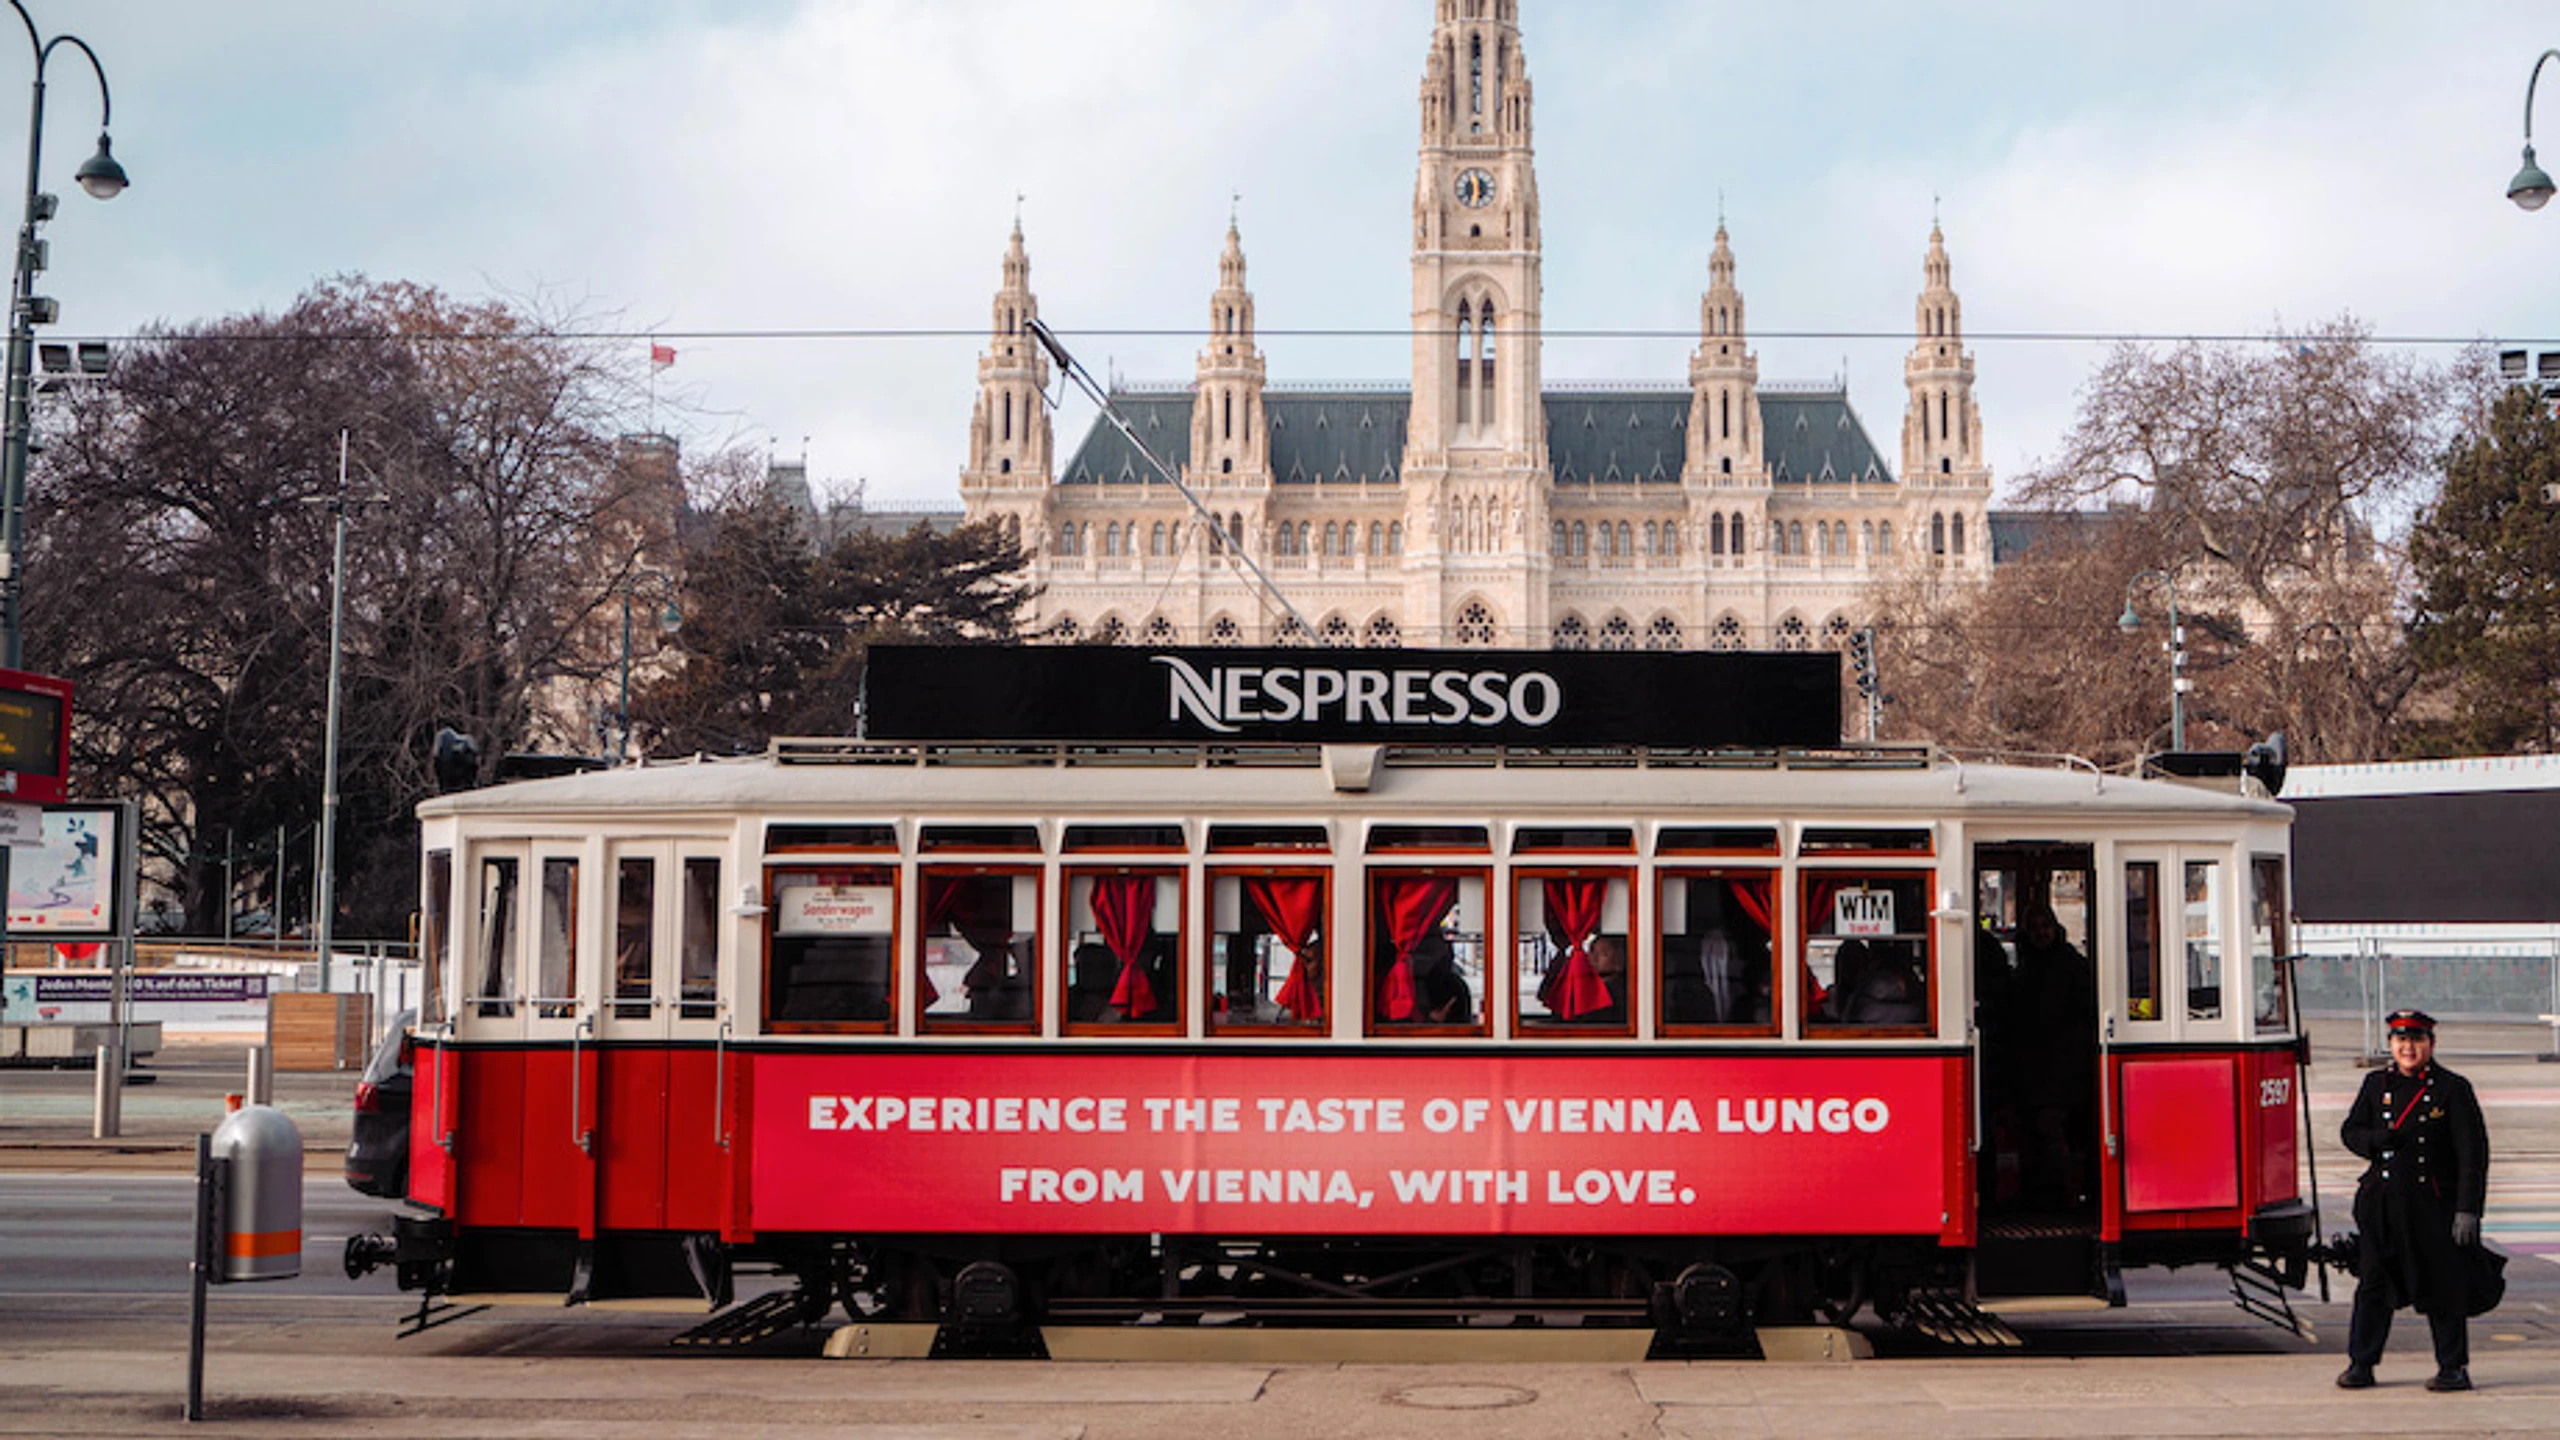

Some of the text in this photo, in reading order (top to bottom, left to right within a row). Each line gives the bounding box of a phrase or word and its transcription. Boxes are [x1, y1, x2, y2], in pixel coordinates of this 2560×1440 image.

[1150, 655, 1561, 733] NESPRESSO
[802, 902, 875, 917] Sonderwagen
[1839, 895, 1889, 920] WTM
[39, 978, 74, 991] Jeden
[75, 978, 112, 991] Monta
[177, 978, 202, 991] dein
[2260, 1078, 2290, 1107] 2597
[810, 1097, 1889, 1133] EXPERIENCE THE TASTE OF VIENNA LUNGO
[1001, 1169, 1695, 1208] FROM VIENNA, WITH LOVE.
